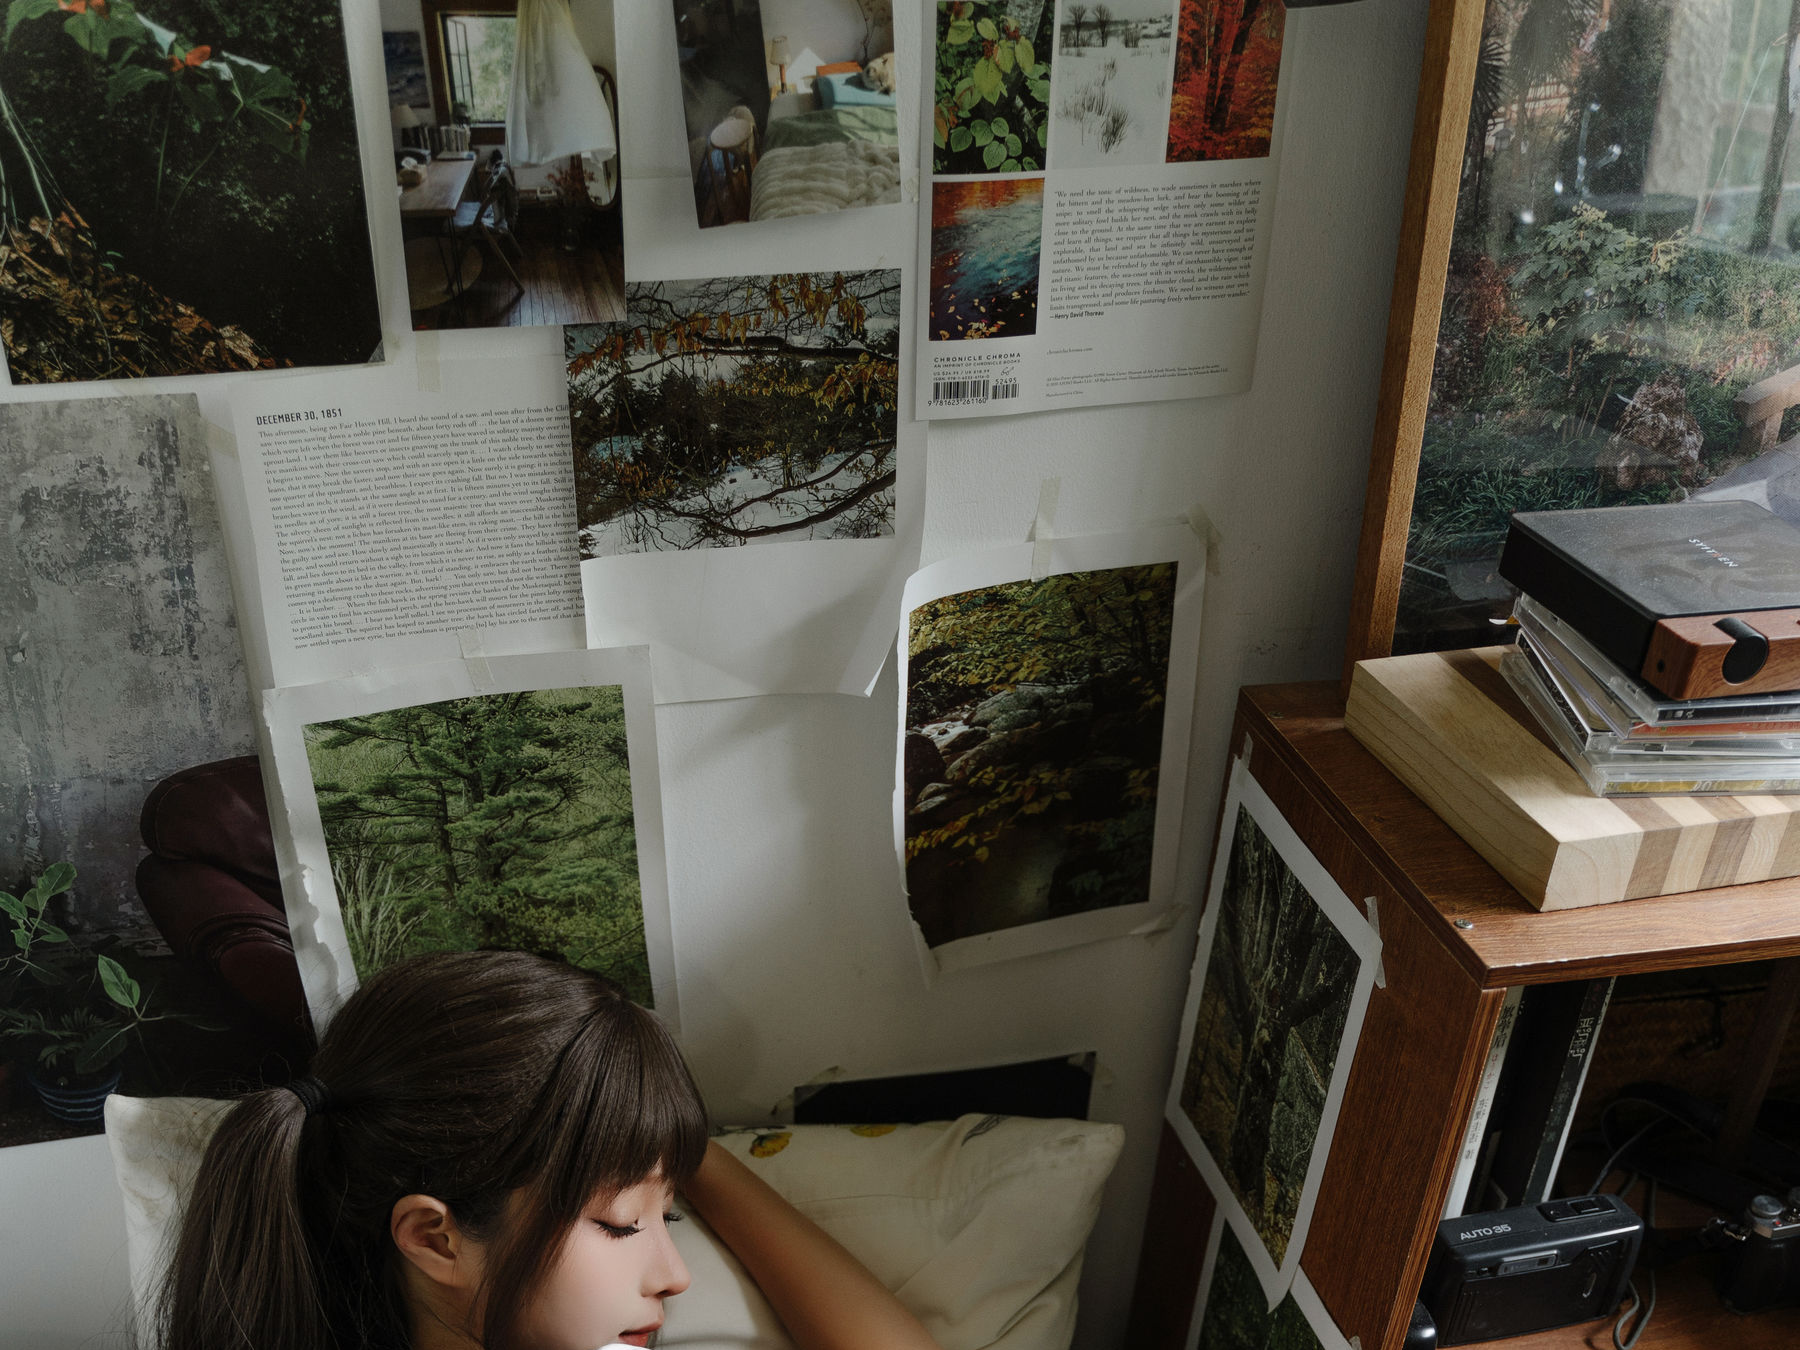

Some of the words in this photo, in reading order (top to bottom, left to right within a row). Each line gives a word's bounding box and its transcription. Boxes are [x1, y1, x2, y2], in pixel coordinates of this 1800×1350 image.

[1117, 206, 1150, 214] whispering
[1151, 203, 1169, 212] sedge
[1192, 201, 1206, 209] only
[1244, 207, 1257, 216] belly
[1236, 217, 1256, 226] explore
[256, 412, 302, 425] DECEMBER
[304, 411, 318, 421] 30,
[321, 408, 342, 419] 1851
[398, 415, 417, 423] heard
[430, 412, 450, 420] sound
[372, 429, 386, 437] pine
[261, 448, 281, 456] which
[466, 428, 488, 436] waved
[1460, 1228, 1493, 1240] AUTO
[1493, 1224, 1512, 1233] 35
